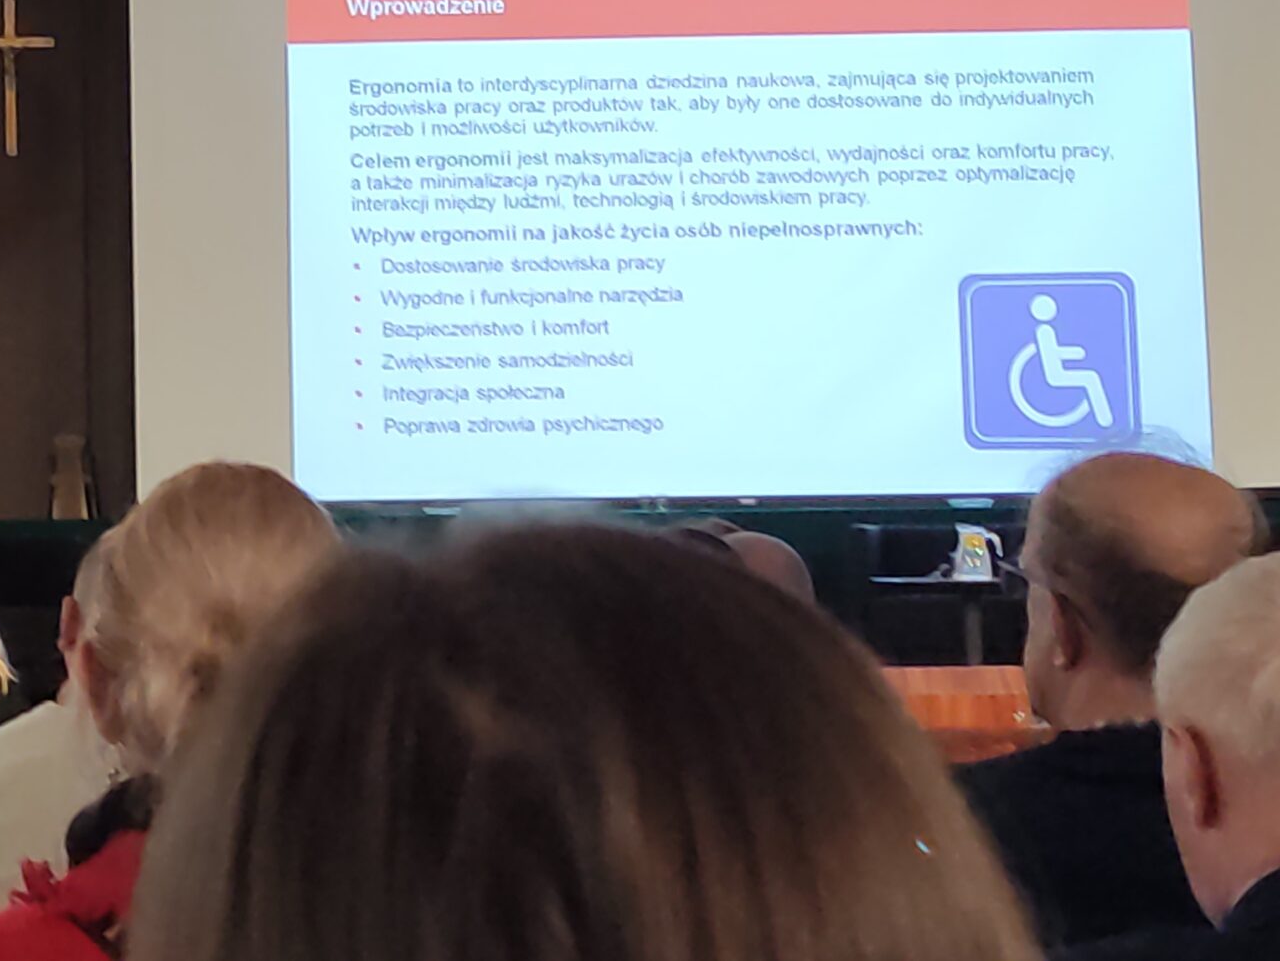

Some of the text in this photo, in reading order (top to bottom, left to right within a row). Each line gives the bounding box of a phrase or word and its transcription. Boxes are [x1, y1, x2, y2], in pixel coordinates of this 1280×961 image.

[348, 69, 1095, 98] Ergonomia to interdyscyplinarna dziedzina naukowa, zajmująca się projektowaniem
[348, 100, 447, 117] środowiska
[454, 102, 502, 117] pracy
[508, 100, 546, 114] oraz
[552, 98, 643, 115] produktów
[688, 95, 720, 114] aby
[726, 94, 761, 114] były
[767, 96, 801, 110] one
[806, 94, 923, 109] dostosowane
[930, 91, 953, 107] do
[959, 90, 1095, 109] indywidualnych
[349, 122, 415, 140] potrzeb
[431, 120, 527, 136] możliwości
[533, 118, 658, 137] użytkowników.
[349, 143, 1115, 171] Celem ergonomii jest maksymalizacja efektywności, wydajności oraz komfortu pracy,
[350, 178, 362, 191] a
[366, 175, 413, 191] także
[420, 174, 539, 190] minimalizacja
[545, 172, 602, 191] ryzyka
[609, 172, 673, 186] urazów
[689, 169, 750, 185] chorób
[756, 168, 870, 186] zawodowych
[877, 168, 948, 186] poprzez
[955, 165, 1076, 184] optymalizację
[351, 196, 429, 213] interakcji
[434, 194, 496, 213] między
[572, 192, 674, 210] technologią
[691, 191, 812, 206] środowiskiem
[350, 227, 416, 246] Wpływ
[420, 225, 517, 246] ergonomii
[522, 228, 546, 241] na
[552, 224, 616, 243] jakość
[620, 224, 670, 243] życia
[674, 222, 723, 238] osób
[381, 256, 666, 274] Dostosowanie środowiska pracy
[379, 290, 465, 310] Wygodne
[480, 289, 594, 307] funkcjonalne
[598, 286, 684, 305] narzędzia
[541, 319, 610, 336] komfort
[381, 352, 634, 372] Zwiększenie samodzielności
[383, 385, 566, 405] Integracja społeczna
[383, 417, 665, 436] Poprawa zdrowia psychicznego
